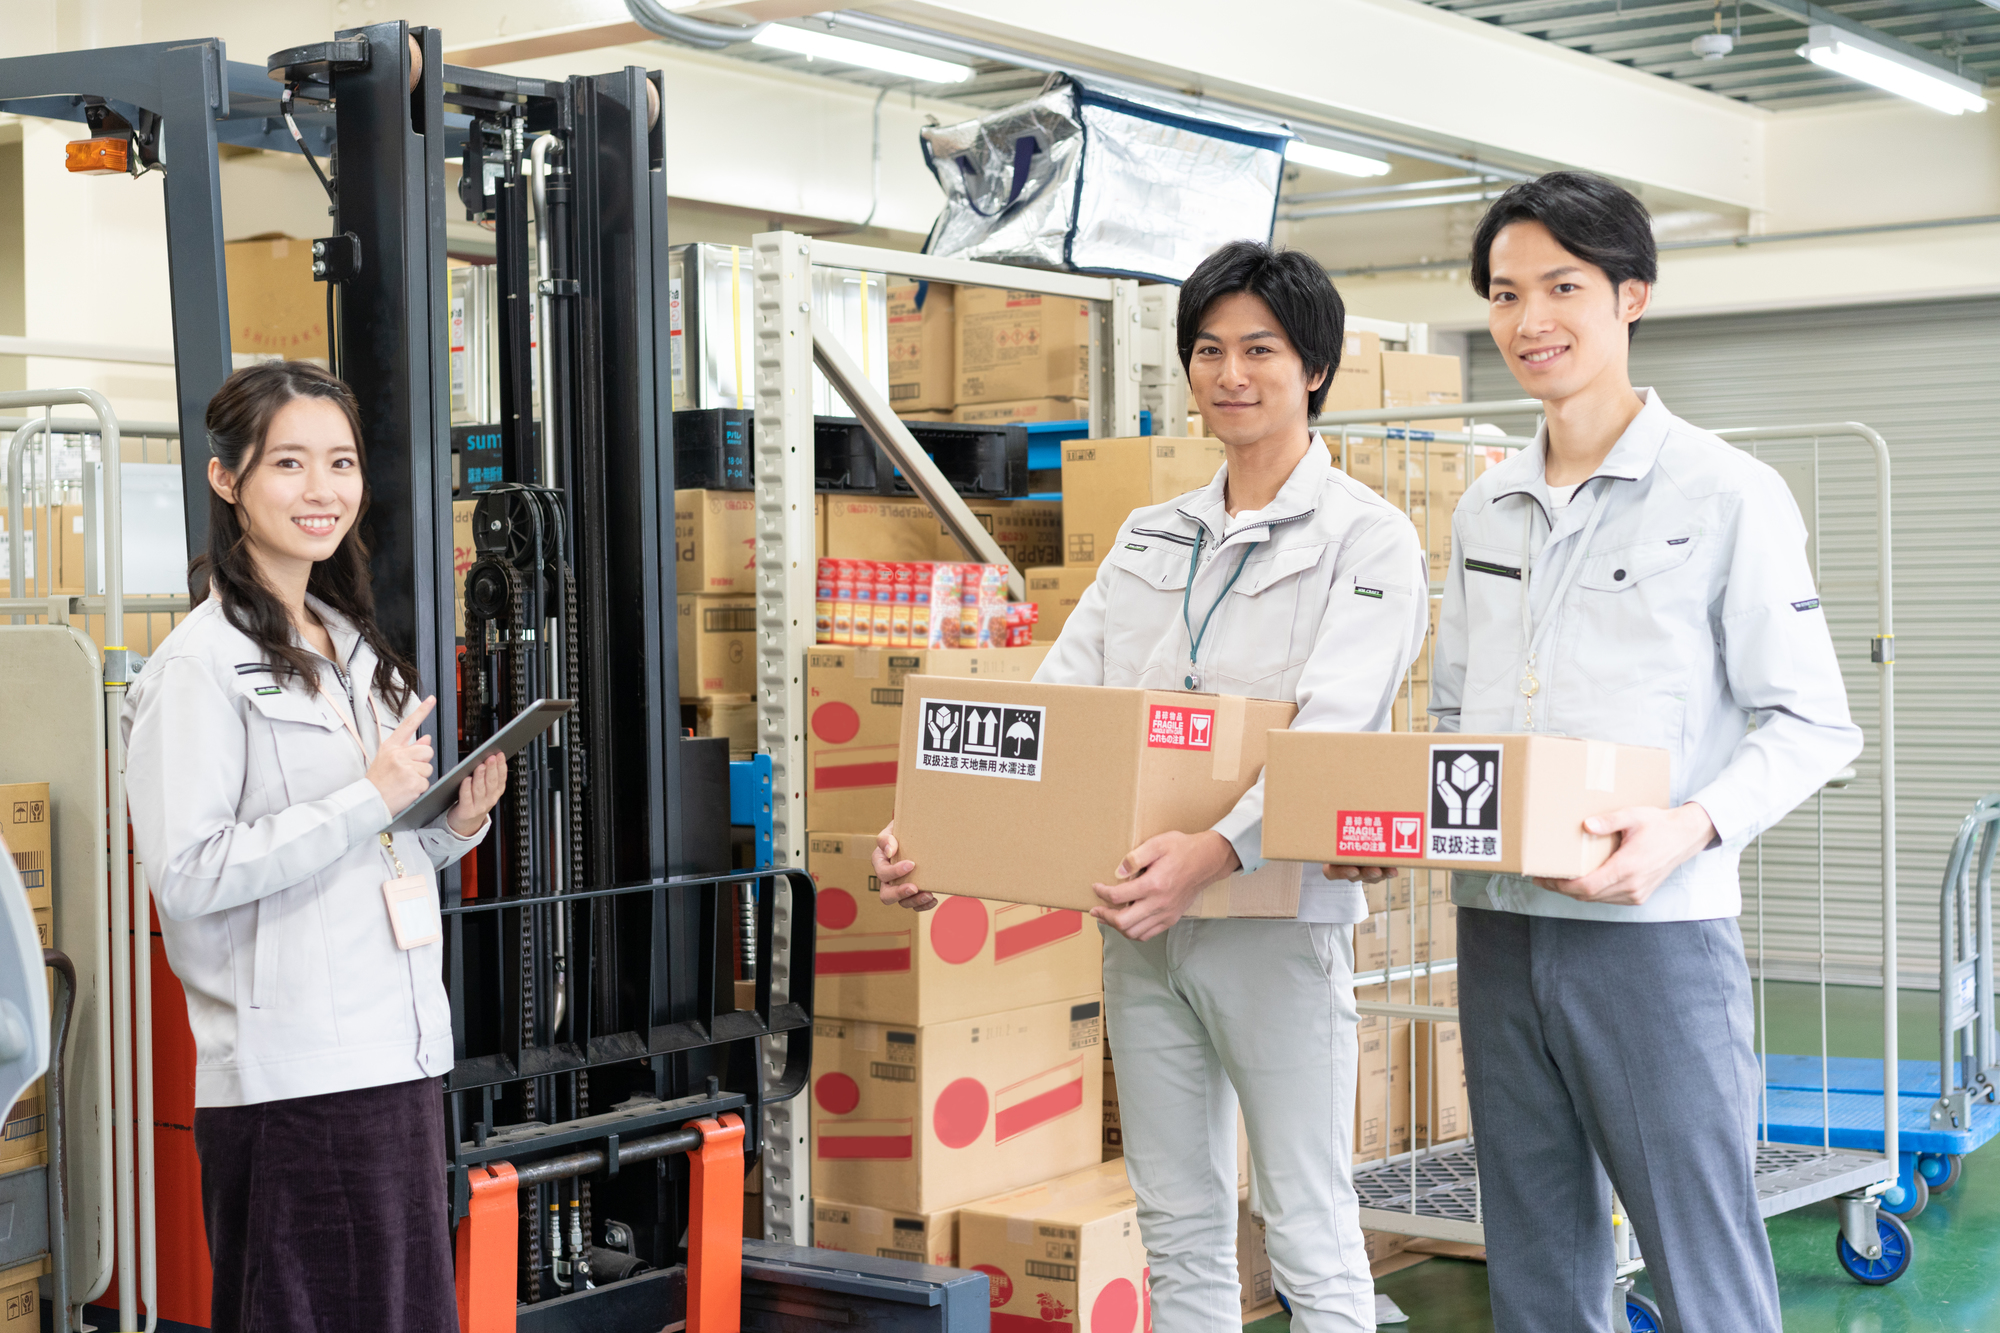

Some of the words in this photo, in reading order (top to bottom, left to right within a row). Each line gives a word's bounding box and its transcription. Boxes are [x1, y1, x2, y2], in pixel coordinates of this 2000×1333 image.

[1153, 720, 1184, 730] FRAGILE
[923, 753, 959, 769] 取扱注意
[960, 757, 997, 772] 天地無用
[1343, 826, 1383, 836] FRAGILE
[1339, 842, 1386, 852] われもの注意
[1432, 835, 1497, 855] 取扱注意
